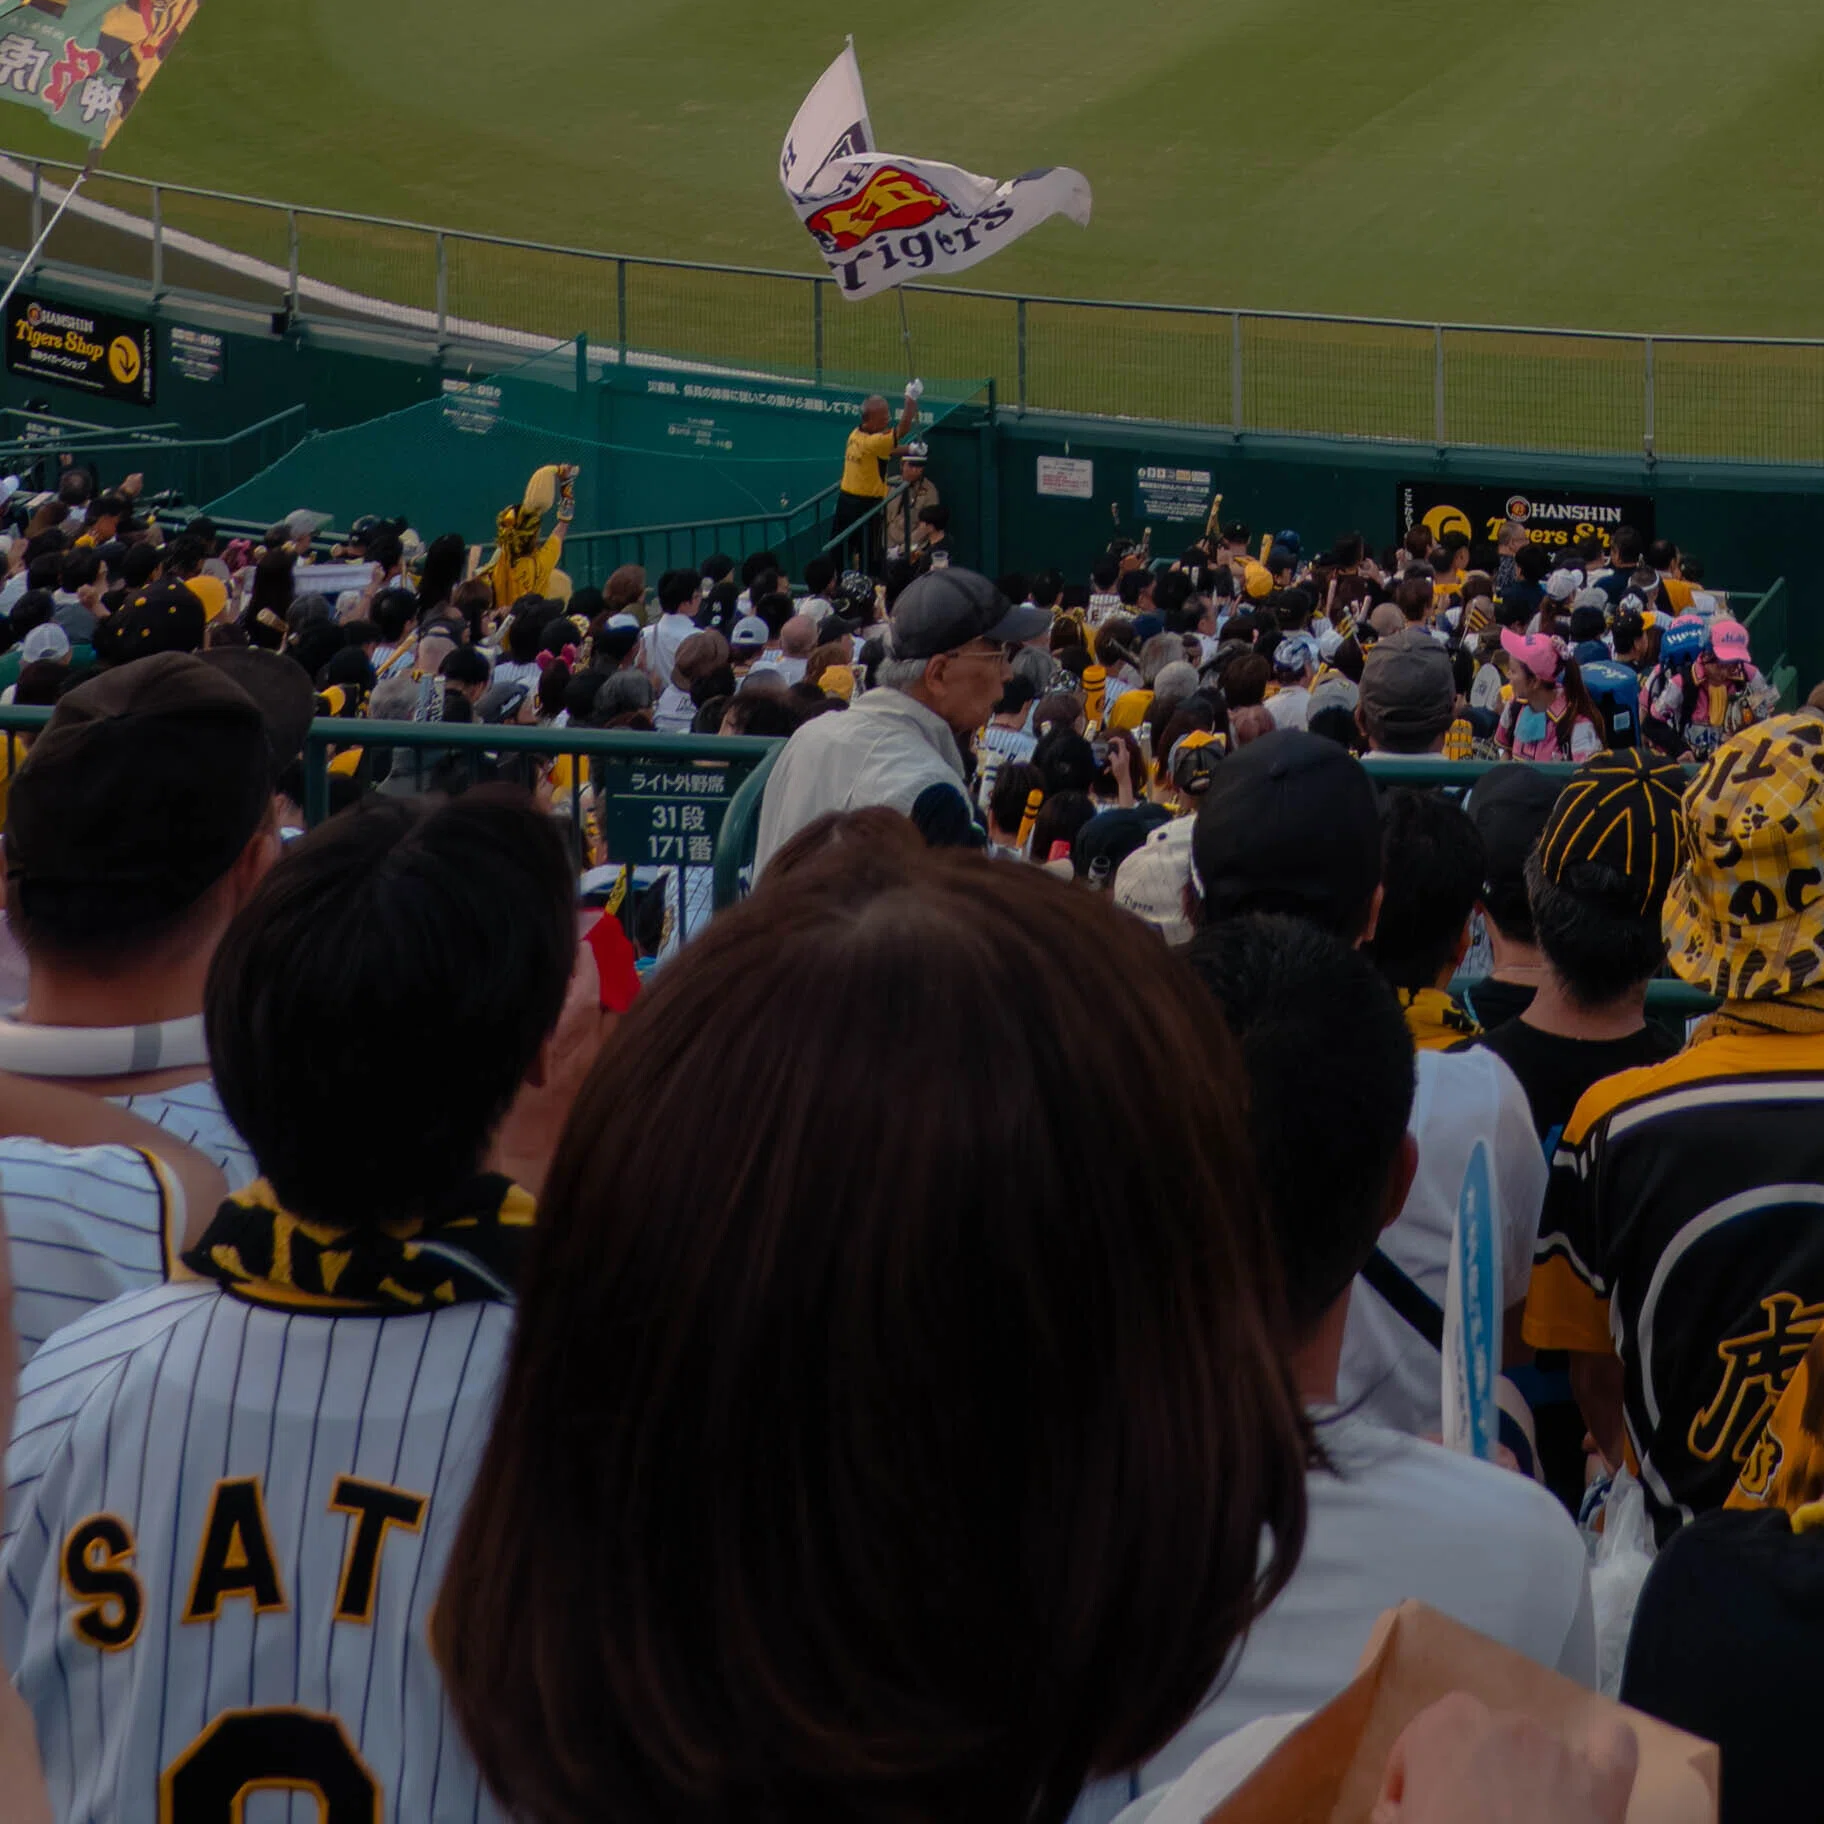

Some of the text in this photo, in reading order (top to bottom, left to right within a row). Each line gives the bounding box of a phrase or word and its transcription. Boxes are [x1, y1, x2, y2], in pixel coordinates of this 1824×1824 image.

[828, 200, 1015, 291] Tigers
[15, 316, 63, 350] Tigers
[64, 330, 105, 364] Shop
[1531, 502, 1623, 524] HANSHIN
[1485, 516, 1569, 546] Ters
[630, 772, 726, 794] ライト外野席
